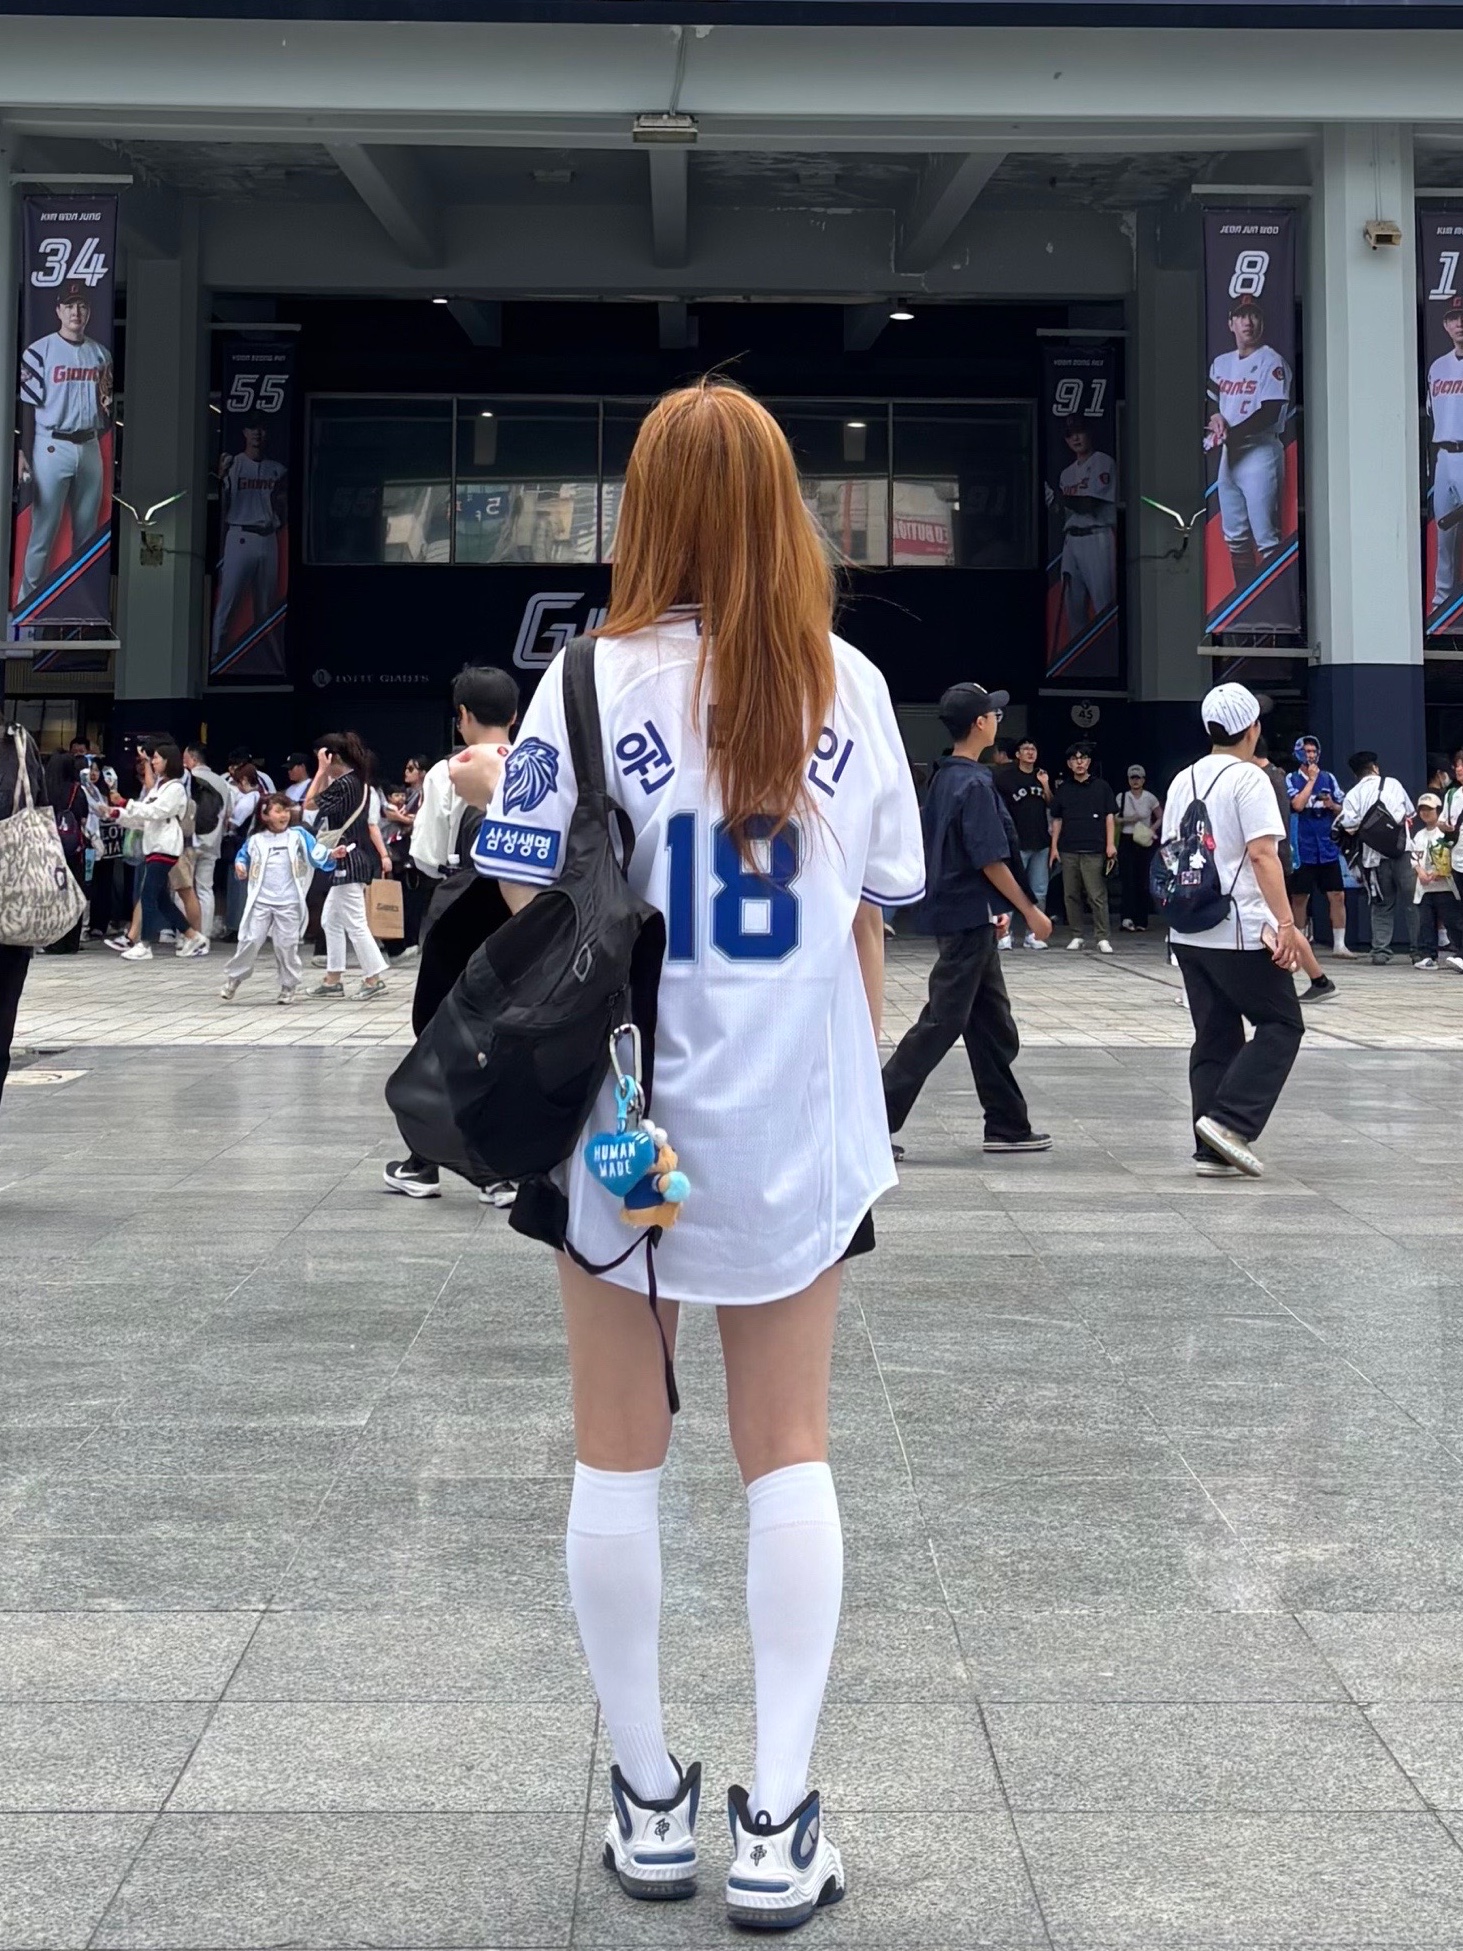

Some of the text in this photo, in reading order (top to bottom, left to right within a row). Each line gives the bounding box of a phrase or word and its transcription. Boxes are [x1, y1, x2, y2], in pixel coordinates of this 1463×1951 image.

[41, 212, 58, 220] KIM
[79, 212, 101, 220] JUNG
[1220, 225, 1242, 234] JEON
[1242, 225, 1259, 234] JUN
[31, 238, 109, 287] 34
[1229, 250, 1270, 298] 8
[227, 374, 289, 413] 55
[1052, 378, 1107, 417] 91
[1012, 786, 1043, 801] LOTT
[486, 827, 552, 860] 삼성생명
[665, 809, 802, 964] 18
[593, 1141, 636, 1162] HUMAN
[599, 1160, 632, 1178] MADE
